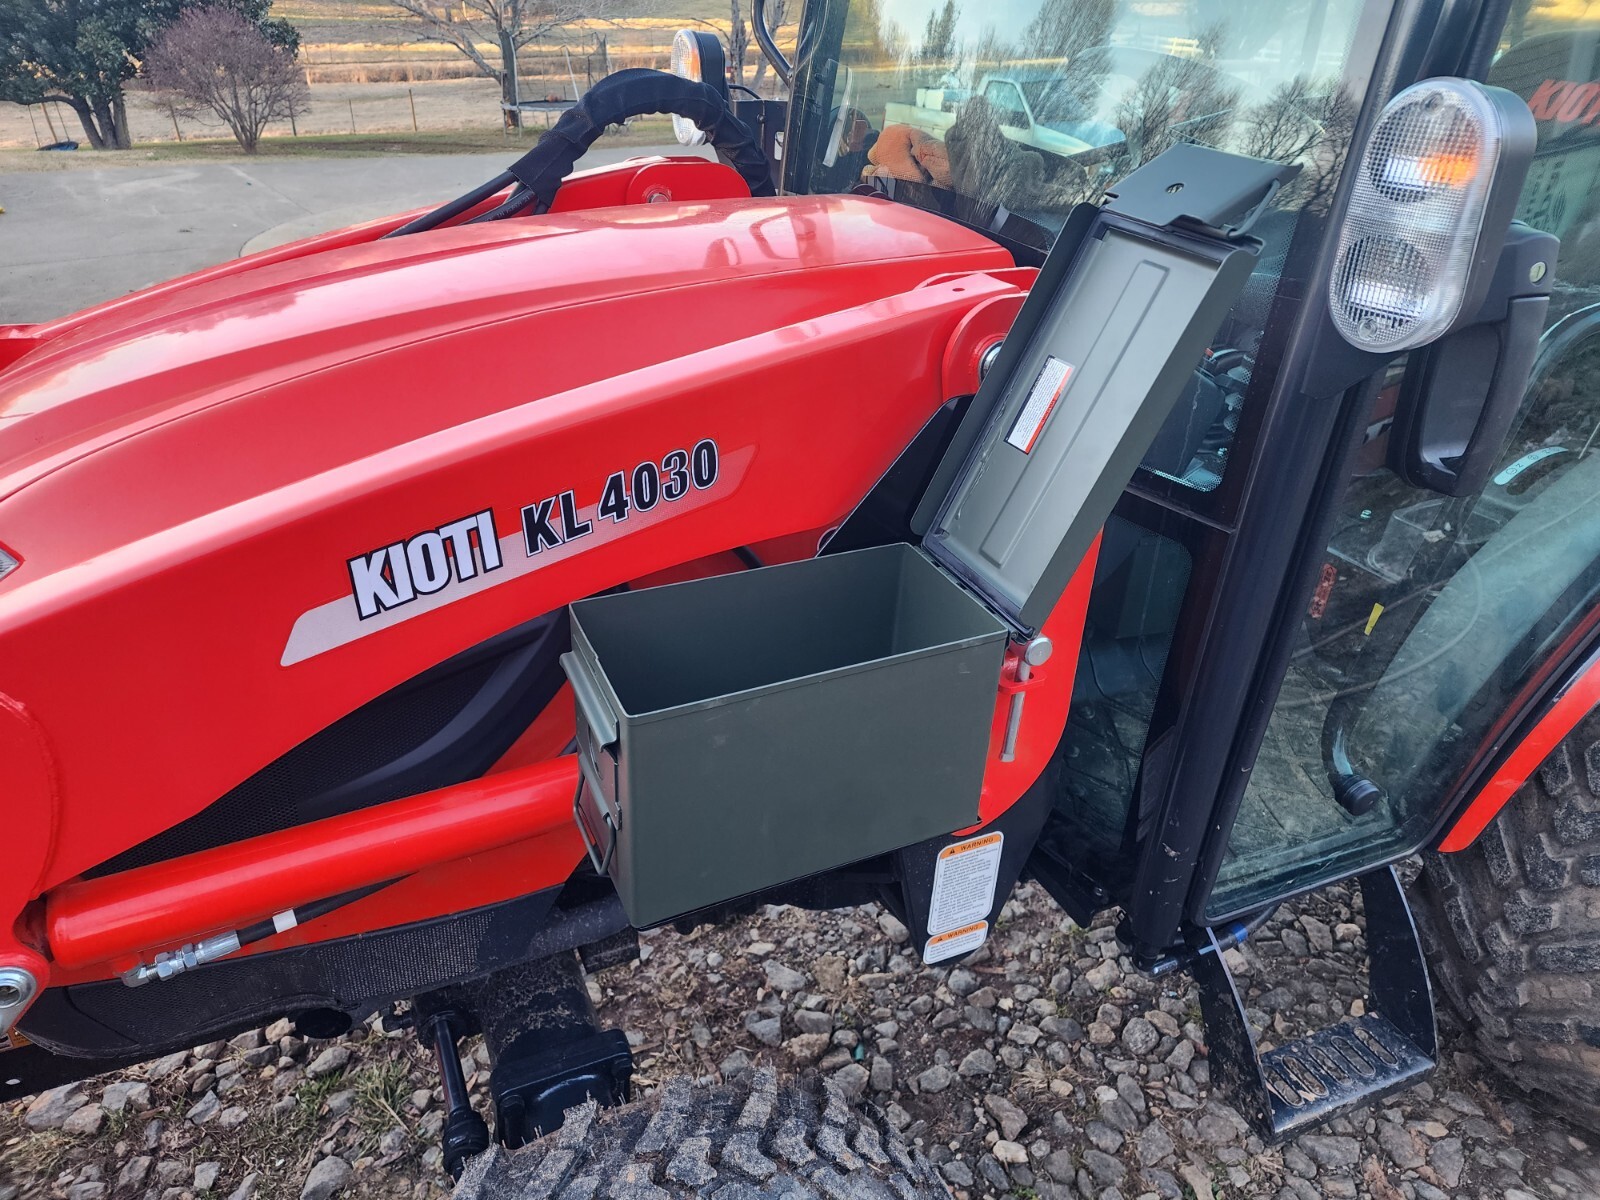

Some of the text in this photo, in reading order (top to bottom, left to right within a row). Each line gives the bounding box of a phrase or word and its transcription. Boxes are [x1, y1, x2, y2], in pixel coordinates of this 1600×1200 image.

[346, 438, 720, 621] KIOTI KL 4030
[960, 836, 994, 851] WARNING
[947, 925, 979, 938] WARNING
